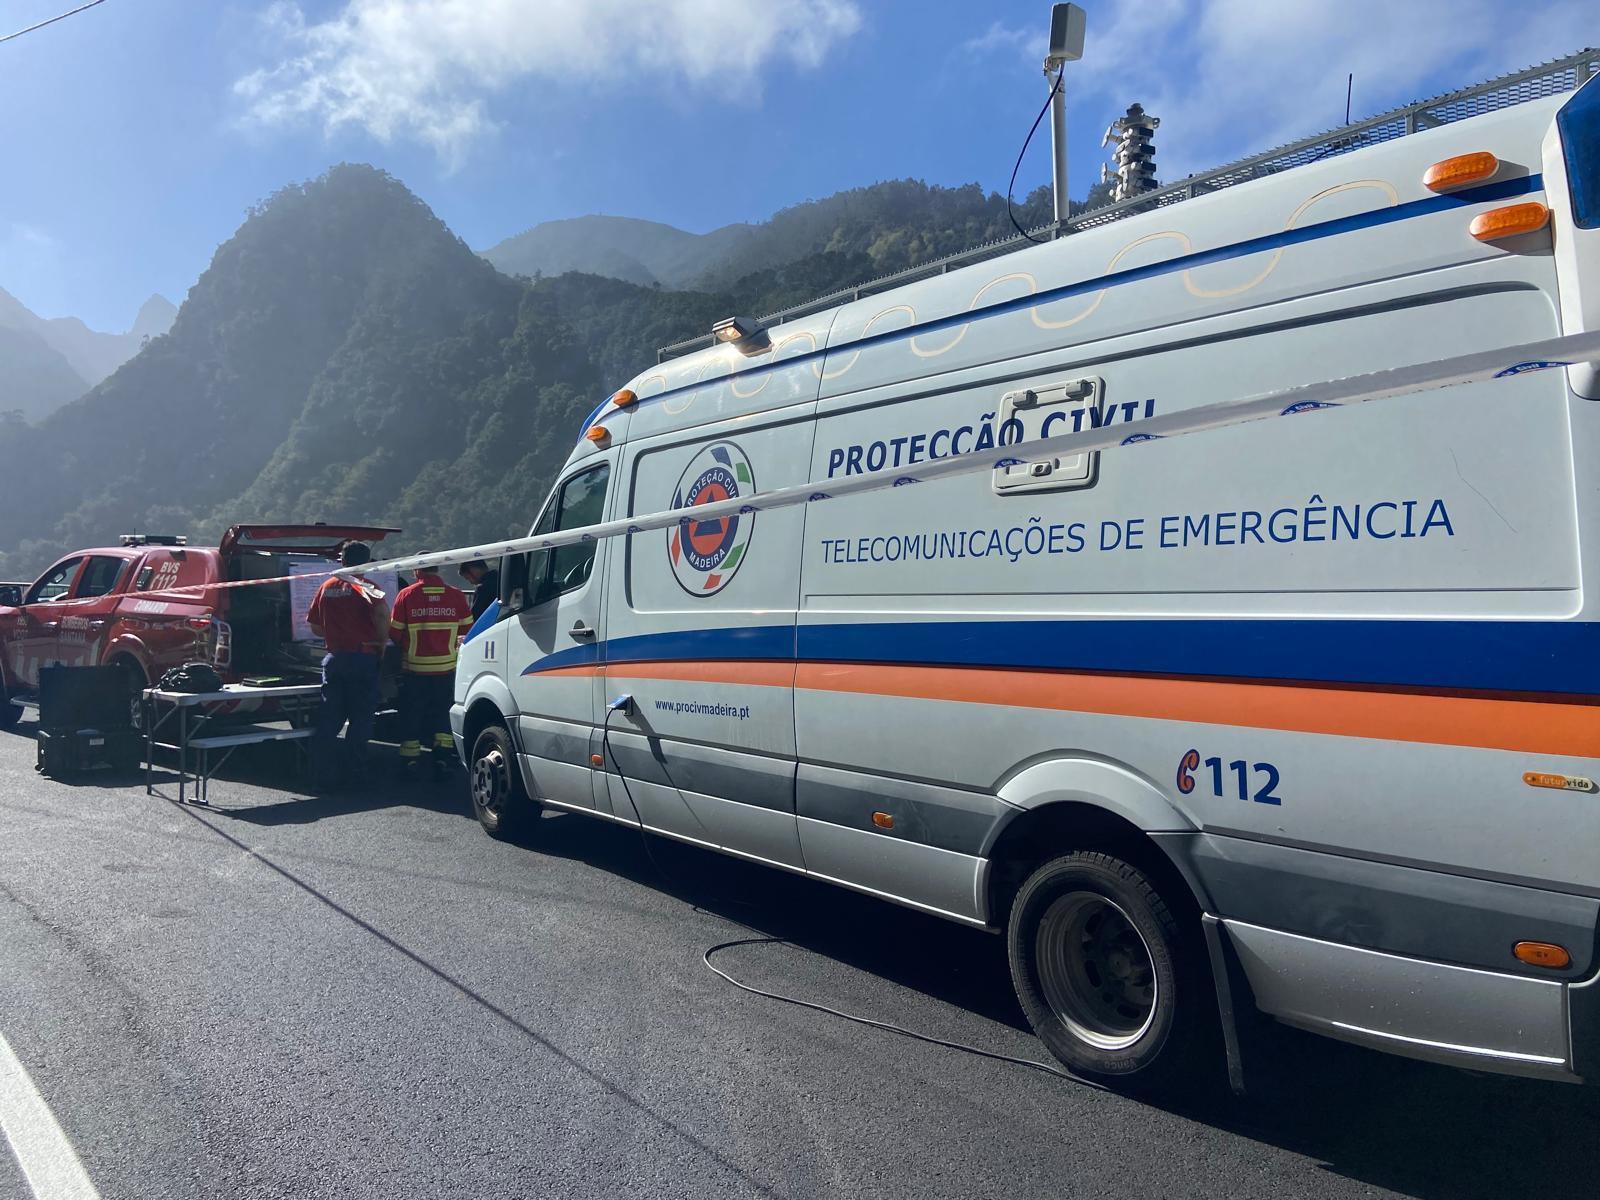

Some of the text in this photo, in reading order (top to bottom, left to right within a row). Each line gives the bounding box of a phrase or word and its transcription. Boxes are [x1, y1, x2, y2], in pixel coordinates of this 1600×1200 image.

[828, 411, 1025, 478] PROTECCÃO
[687, 469, 724, 506] ROTEÇÃO
[821, 494, 1455, 563] TELECOMUNICAÇÕES DE EMERGÊNCIA
[160, 561, 181, 574] BVS
[689, 548, 725, 568] MADEIRA
[411, 607, 457, 618] BOMBEIROS
[655, 700, 750, 721] www.procivmadeira.pt
[1204, 756, 1282, 806] 112
